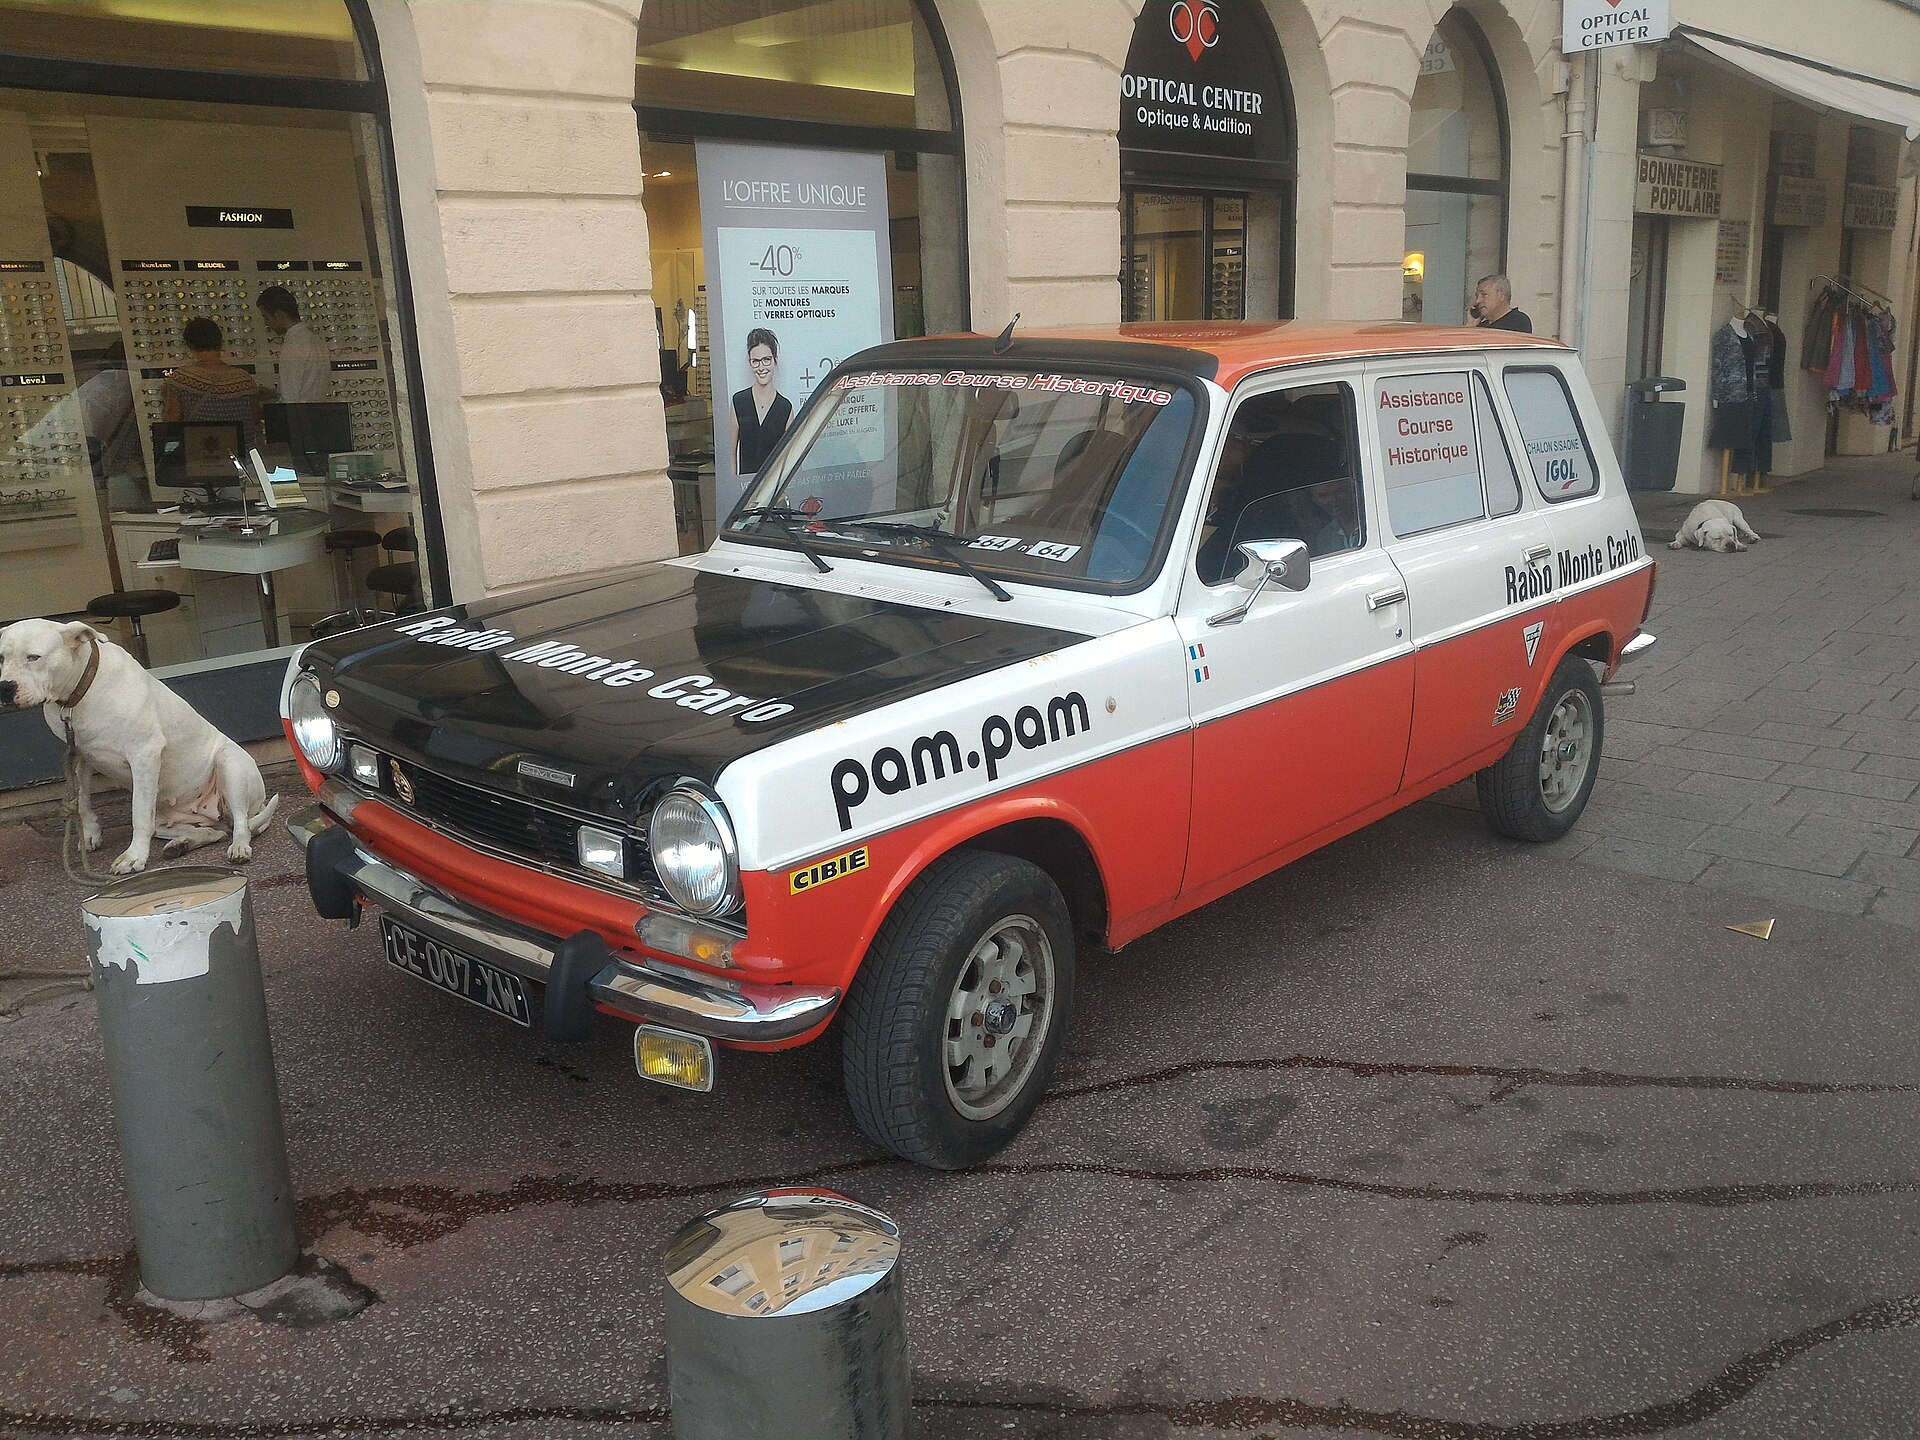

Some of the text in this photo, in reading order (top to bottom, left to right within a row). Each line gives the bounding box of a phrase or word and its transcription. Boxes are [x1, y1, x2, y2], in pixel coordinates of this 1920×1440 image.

[1580, 8, 1650, 30] OPTICAL
[1581, 25, 1649, 47] CENTER
[1121, 73, 1263, 115] OPTICAL CENTER
[1137, 106, 1252, 136] Optique & Audition
[1639, 159, 1719, 190] BONNETERIE
[723, 180, 866, 206] L'OFFRE UNIQUE
[1651, 186, 1720, 214] POPULAIRE
[219, 211, 262, 223] FASHION
[753, 285, 850, 295] SUR TOUTES LES MARQUES
[753, 298, 811, 308] DE MONTURES
[753, 309, 836, 319] ET VERRES OPTIQUES
[831, 370, 1172, 406] Assistance Course Historique
[1380, 390, 1464, 409] Assistance
[836, 418, 854, 427] LUXE
[1398, 418, 1454, 436] Course
[1388, 443, 1469, 466] Historique
[1527, 441, 1553, 455] CHALON
[1546, 458, 1575, 482] IGOL
[1037, 544, 1067, 558] 64
[1505, 530, 1639, 606] Radio Monte Carlo
[394, 616, 796, 722] Radio Monte Carlo
[830, 691, 1091, 832] pam.pam
[520, 764, 571, 786] SIMCA
[391, 924, 519, 1017] CE-007-XW
